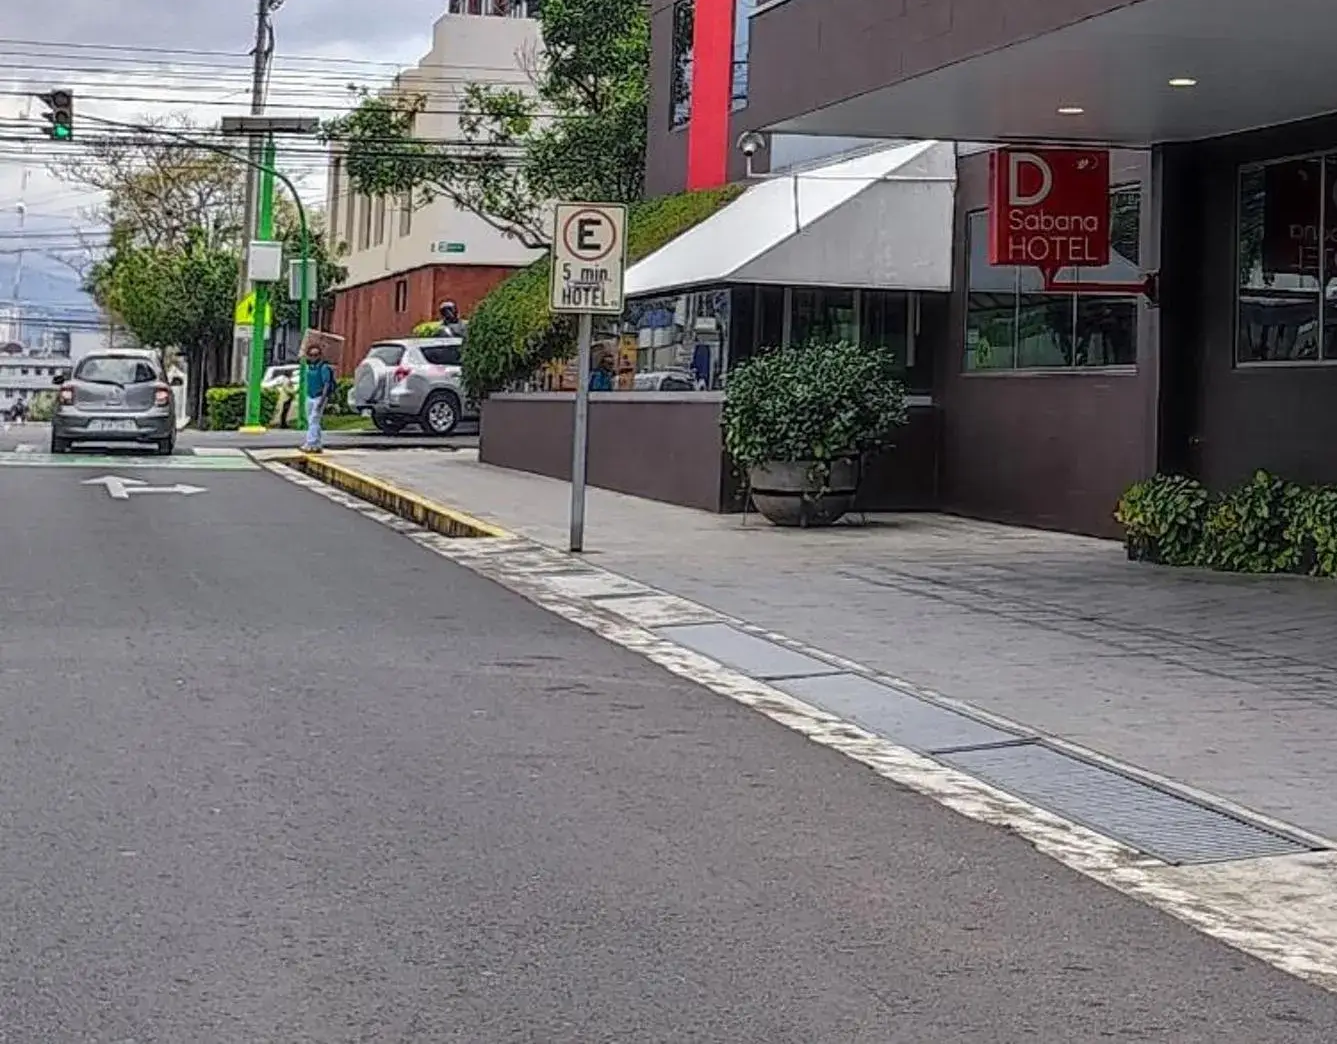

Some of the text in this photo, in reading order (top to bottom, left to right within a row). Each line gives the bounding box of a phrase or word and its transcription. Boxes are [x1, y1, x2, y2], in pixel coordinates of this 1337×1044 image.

[1008, 152, 1053, 206] D
[1008, 209, 1099, 232] Sabana
[577, 218, 602, 250] E
[1008, 236, 1099, 261] HOTEL
[562, 262, 572, 280] 5
[562, 287, 609, 307] HOTEL
